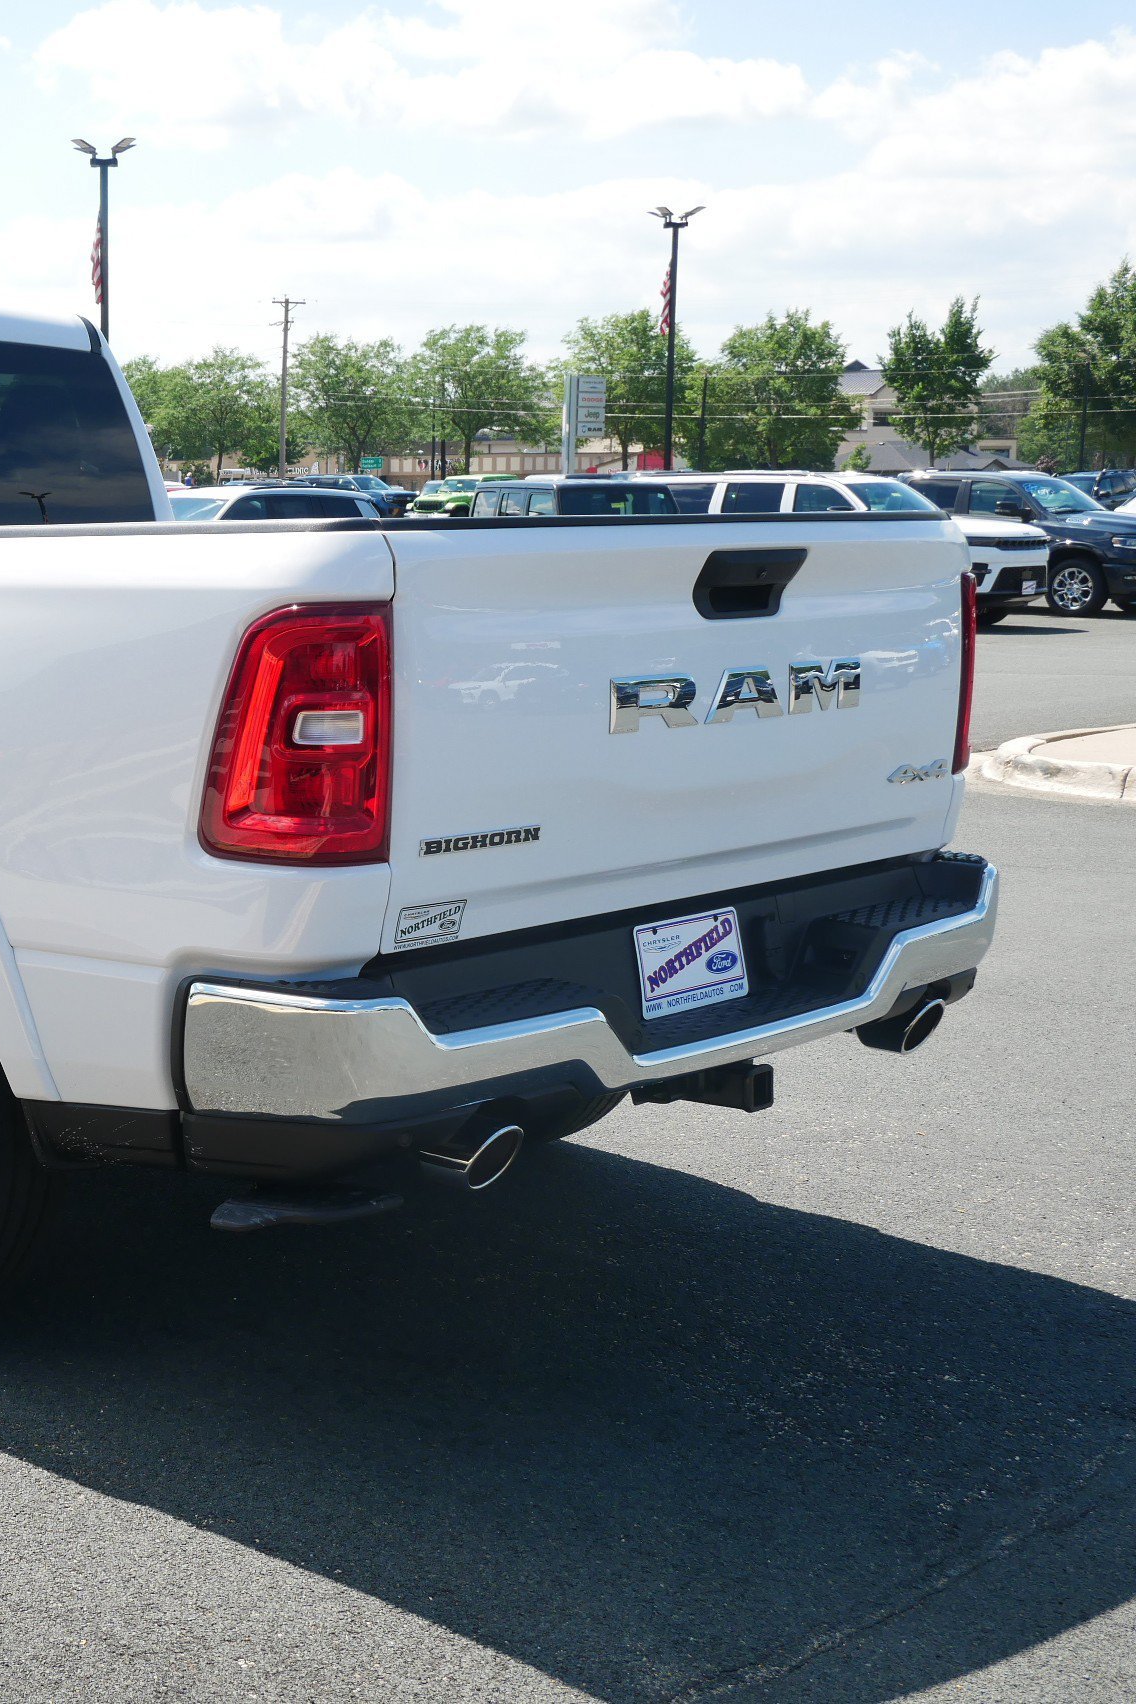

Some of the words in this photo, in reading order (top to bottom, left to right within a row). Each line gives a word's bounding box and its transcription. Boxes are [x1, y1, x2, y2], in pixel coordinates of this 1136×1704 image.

[584, 409, 600, 420] Jeep
[609, 657, 861, 734] RAM
[886, 758, 948, 785] 4x4
[421, 825, 541, 856] BIGHORN
[399, 905, 461, 938] NORTHFIELD
[642, 934, 681, 947] CHRYSLER
[646, 917, 733, 993] NORTHFIELD
[710, 953, 735, 971] Ford
[666, 987, 724, 1008] NORTHFIELDAUTOS
